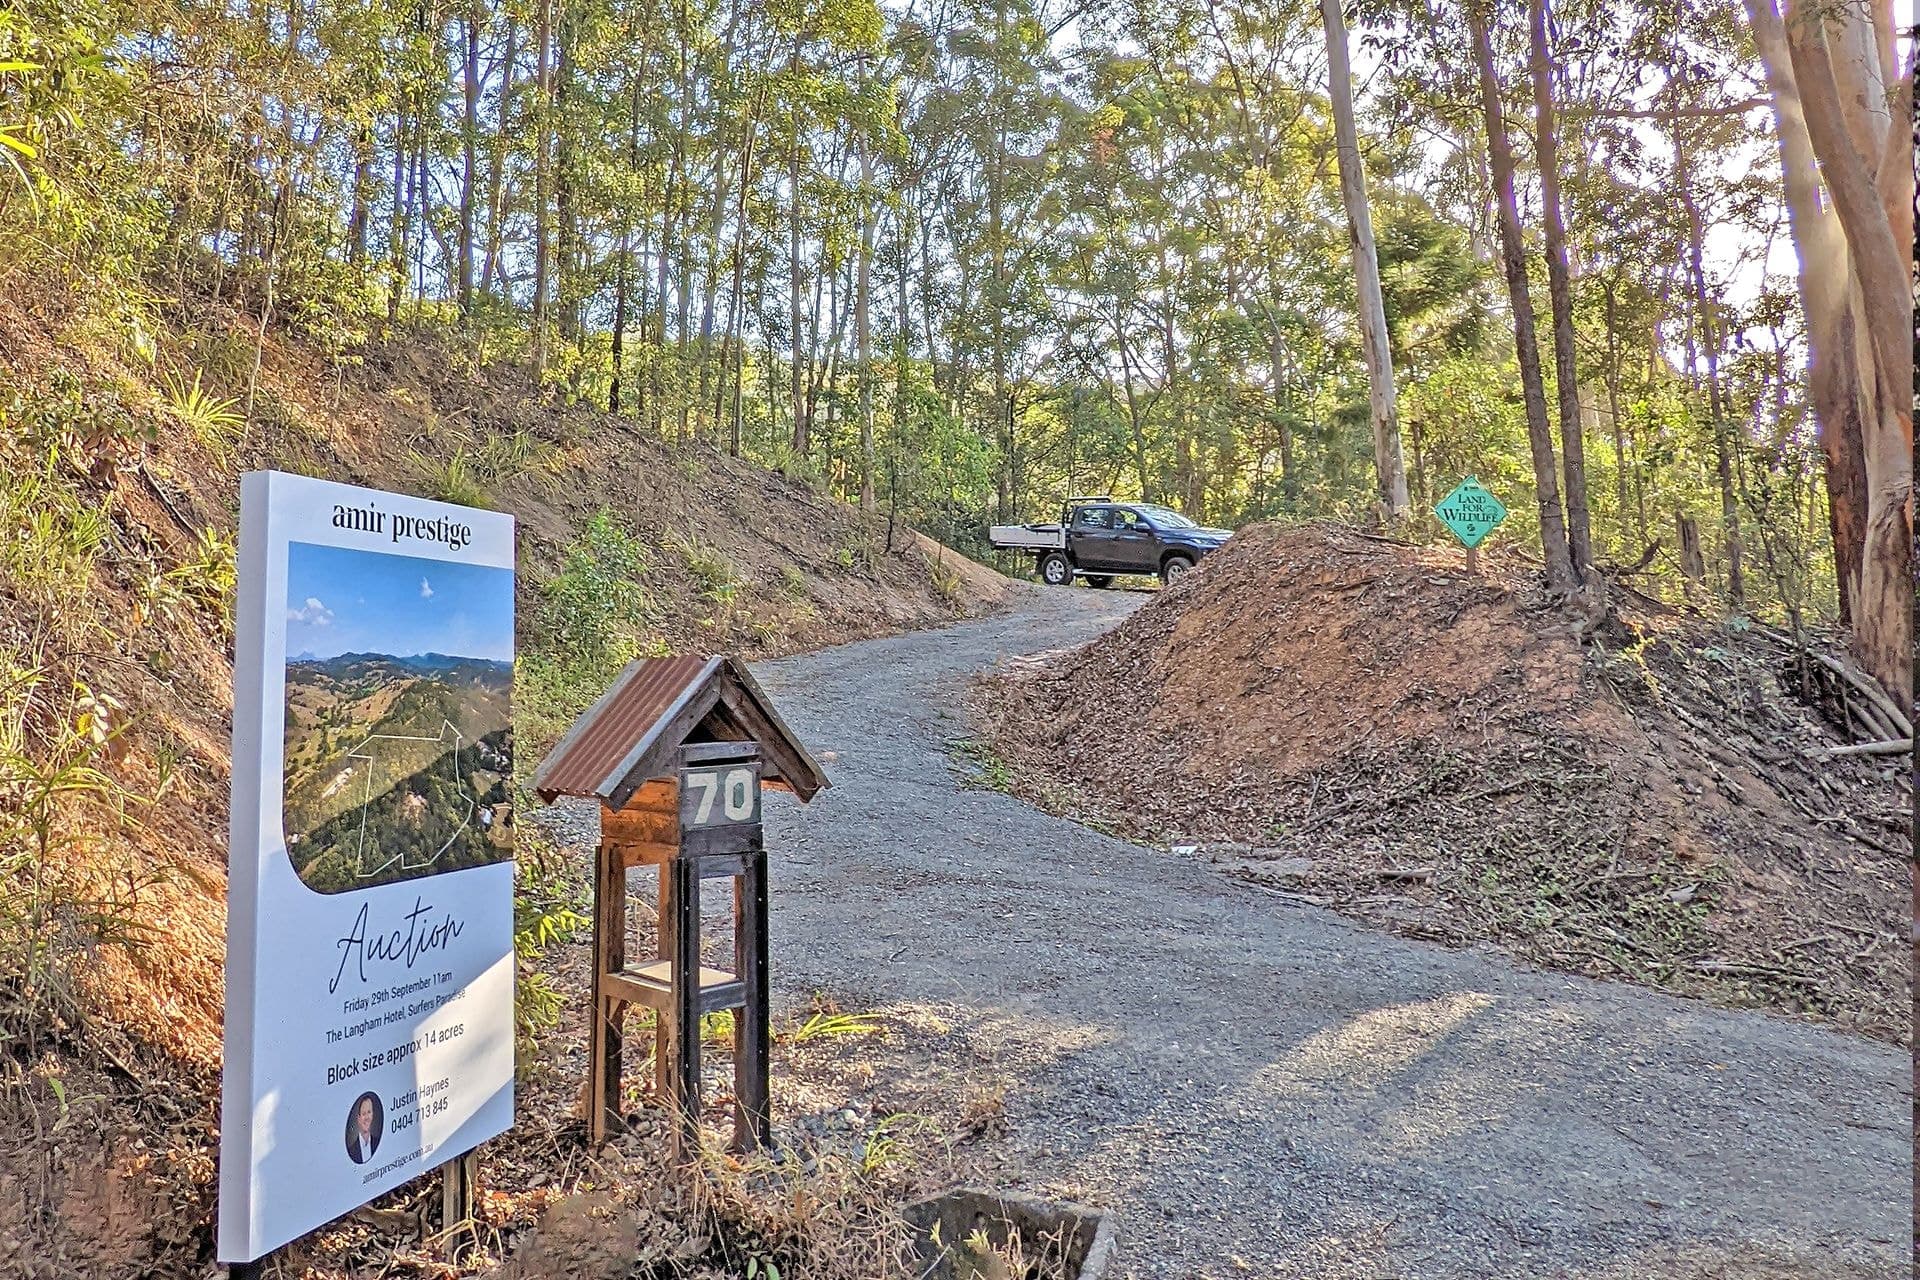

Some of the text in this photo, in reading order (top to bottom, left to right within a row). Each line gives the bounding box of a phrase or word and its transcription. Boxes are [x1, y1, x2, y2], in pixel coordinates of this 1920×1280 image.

[1442, 508, 1498, 522] WILDLIFE
[1458, 494, 1486, 503] LAND
[1462, 504, 1484, 512] FOR
[333, 502, 472, 551] amir prestige
[687, 769, 754, 824] 70
[329, 896, 465, 994] Auction
[343, 971, 452, 1014] Friday 29th September 11am
[326, 989, 466, 1044] The Langham Hotel, Surfers Paradise
[327, 1022, 464, 1085] Block size approx 14 acres
[390, 1077, 449, 1112] Justin Haynes
[391, 1096, 449, 1134] 0404 713 845
